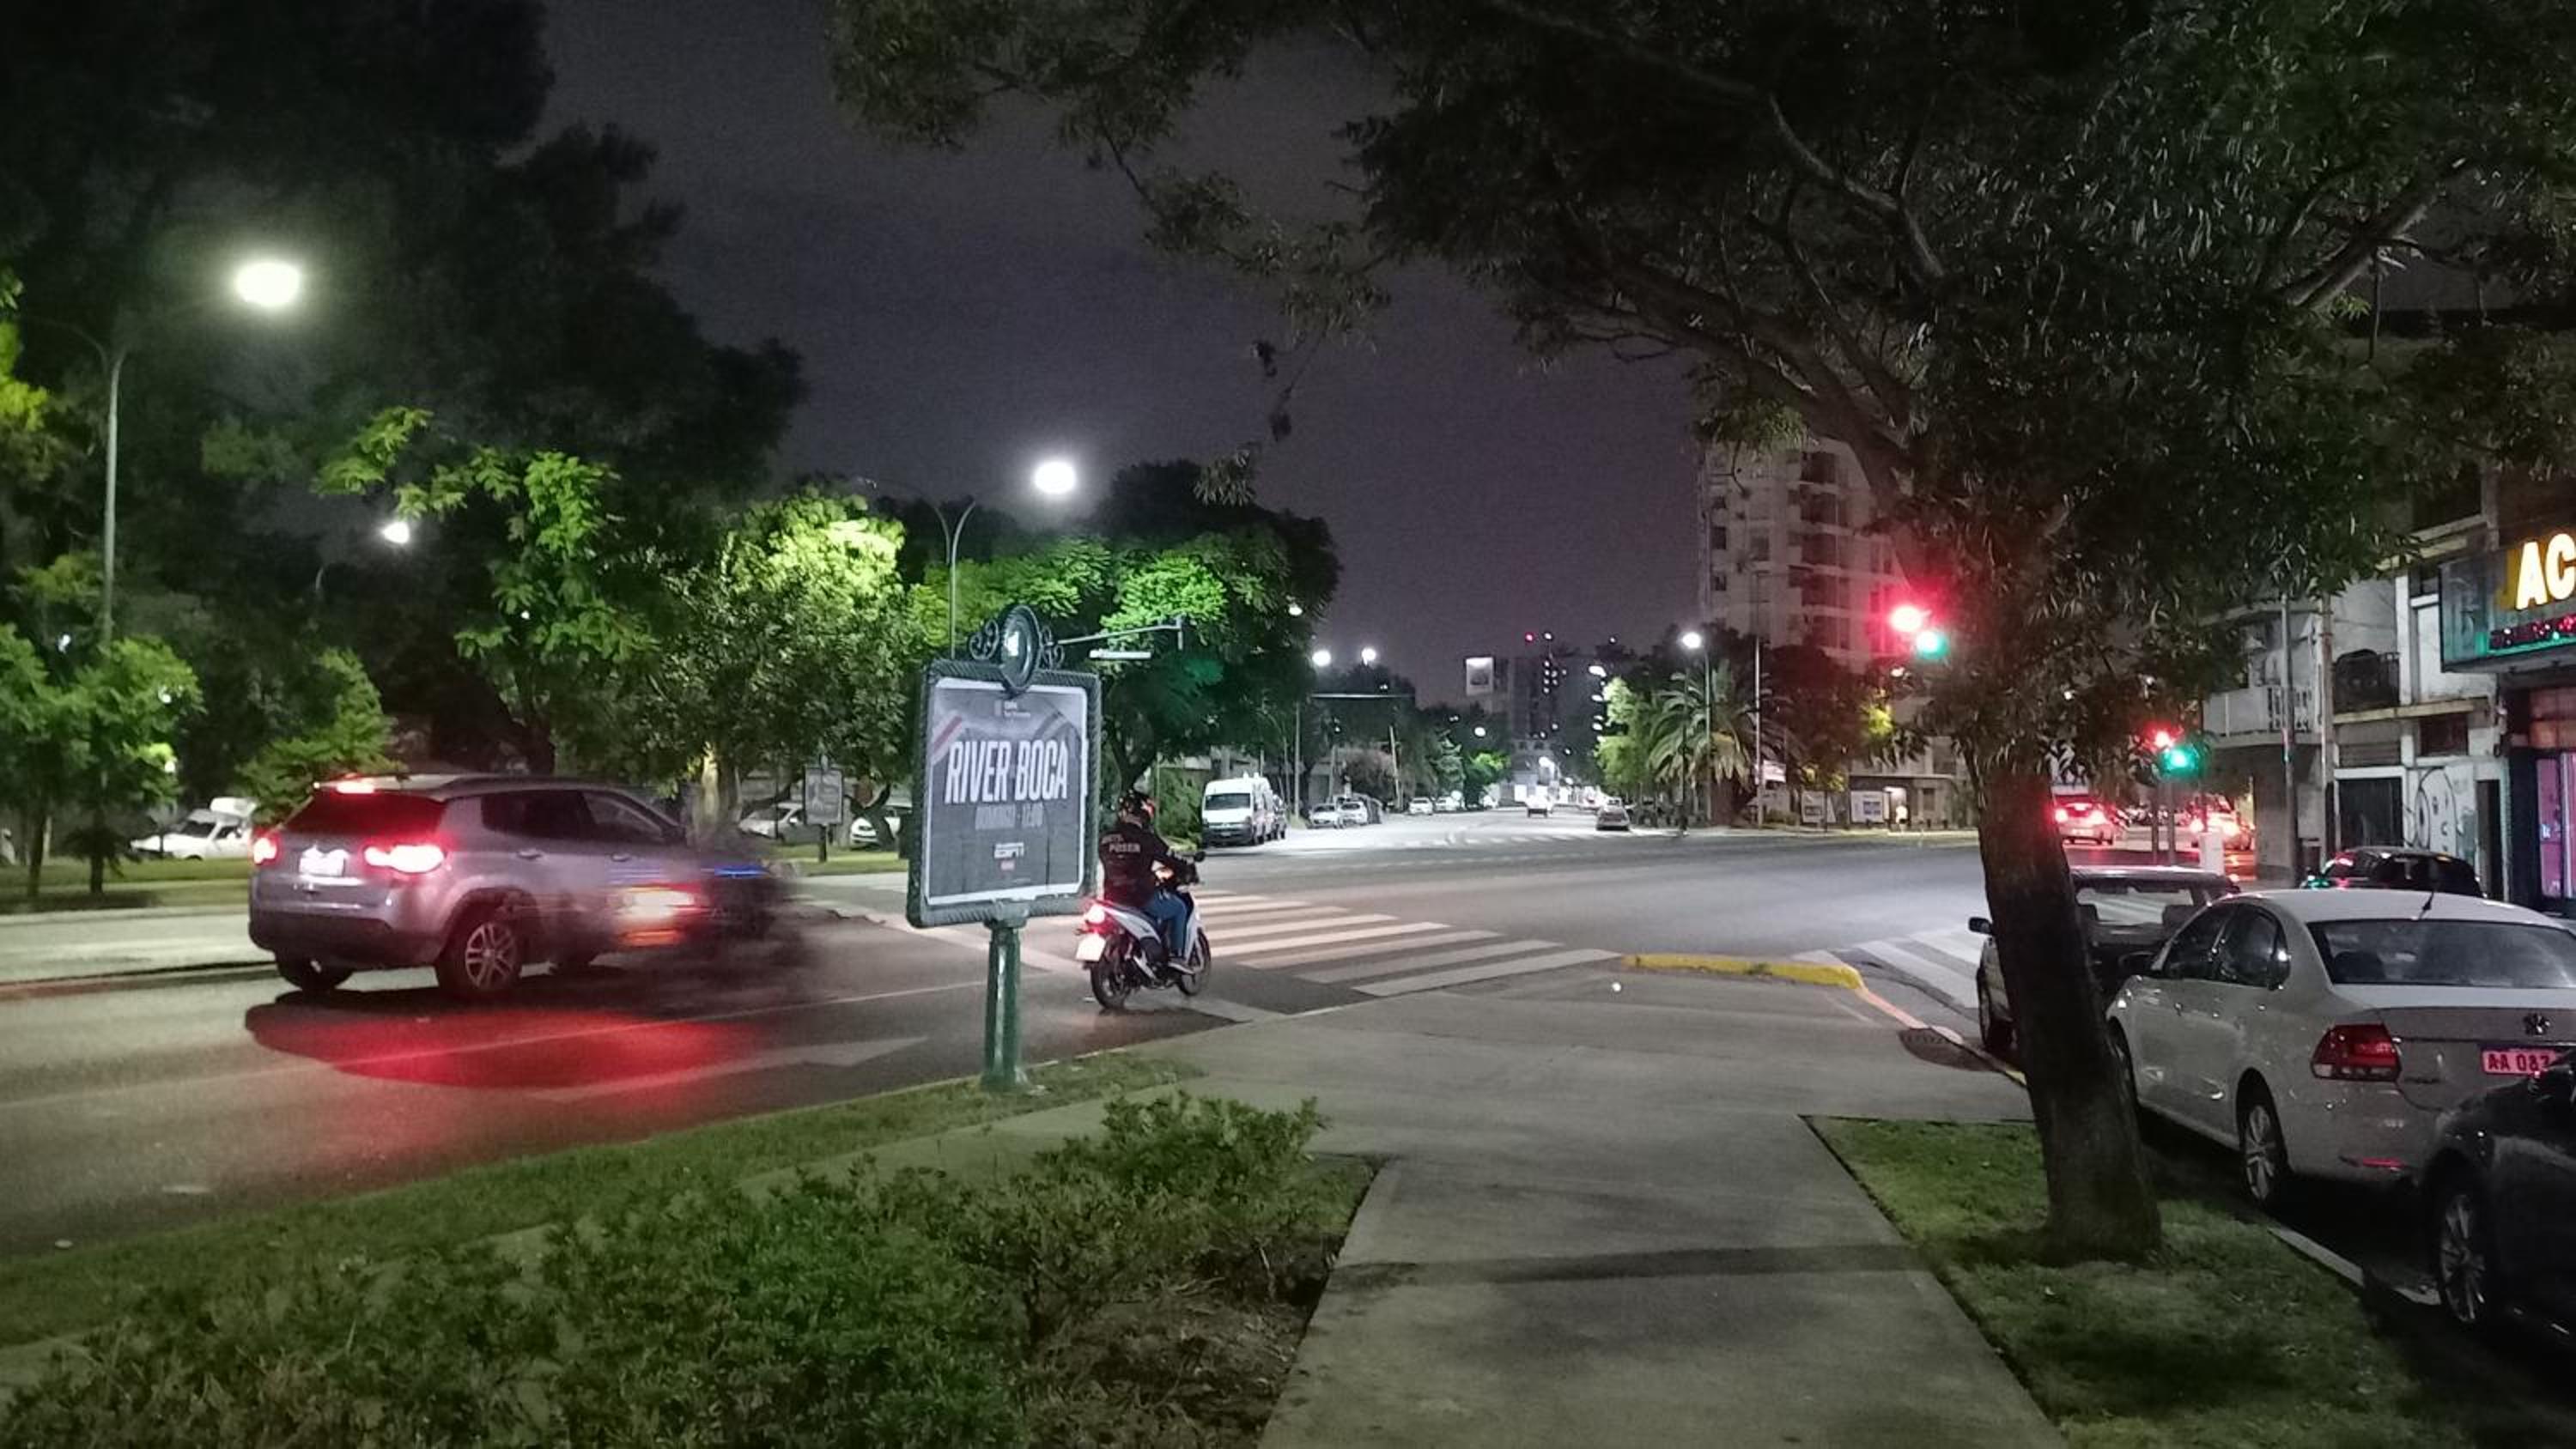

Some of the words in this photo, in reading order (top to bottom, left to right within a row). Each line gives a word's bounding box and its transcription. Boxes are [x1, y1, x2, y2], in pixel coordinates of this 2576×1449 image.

[945, 741, 1012, 803] RIVER
[1015, 740, 1068, 801] BOCA
[2488, 1054, 2511, 1070] AA
